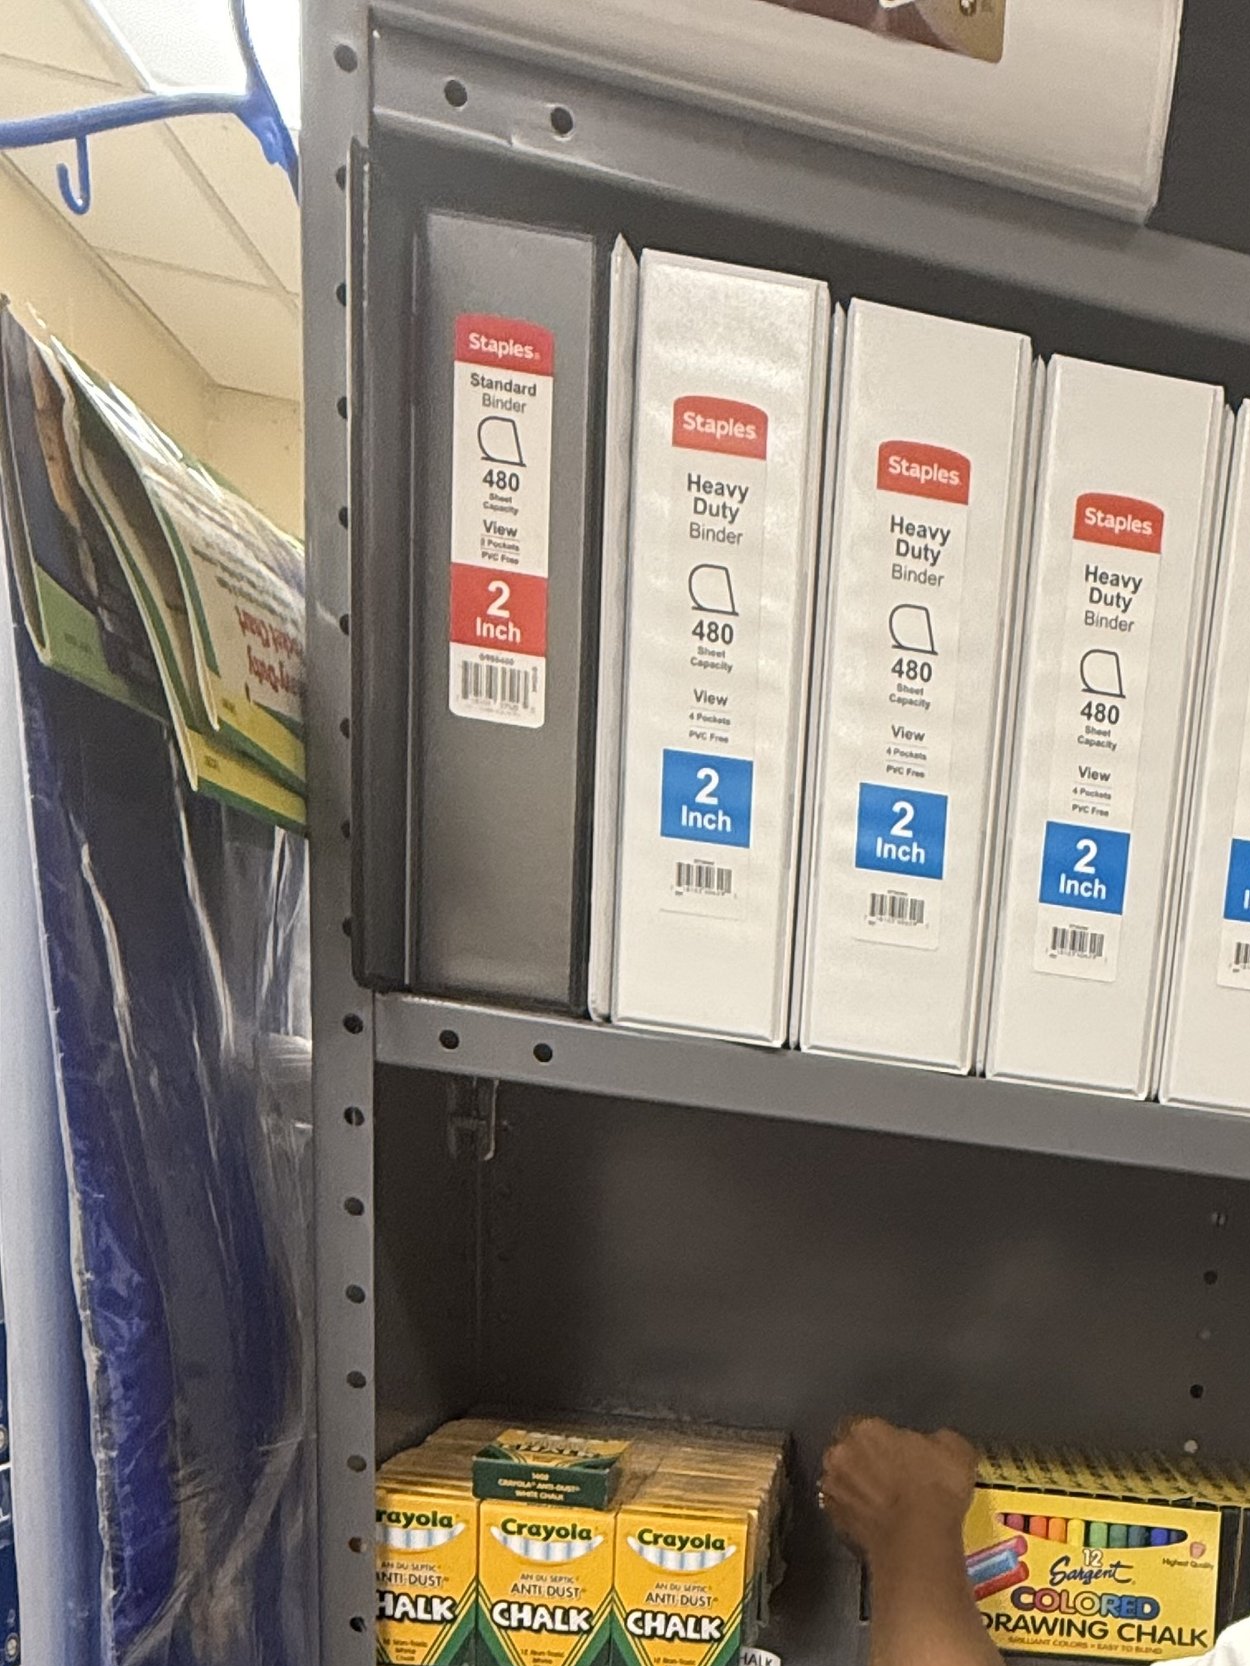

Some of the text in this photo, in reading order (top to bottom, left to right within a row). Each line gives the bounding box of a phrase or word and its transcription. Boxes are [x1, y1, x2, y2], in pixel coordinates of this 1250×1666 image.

[468, 332, 534, 359] Staples
[470, 372, 536, 396] Standard
[482, 394, 526, 413] Binder
[683, 411, 757, 440] Staples
[482, 469, 520, 492] 480
[888, 455, 961, 485] Staples
[687, 472, 749, 504] Heavy
[693, 497, 740, 524] Duty
[1084, 507, 1153, 535] Staples
[483, 519, 518, 538] View
[689, 522, 743, 546] Binder
[891, 515, 951, 547] Heavy
[896, 538, 941, 566] Duty
[892, 563, 944, 587] Binder
[1085, 564, 1143, 594] Heavy
[486, 581, 510, 618] 2
[1089, 587, 1132, 613] Duty
[476, 617, 521, 643] Inch
[692, 620, 734, 645] 480
[1084, 610, 1134, 632] Binder
[891, 658, 932, 683] 480
[693, 689, 728, 707] View
[1080, 701, 1120, 725] 480
[891, 725, 925, 742] View
[695, 767, 720, 805] 2
[1078, 765, 1111, 782] View
[681, 805, 732, 832] Inch
[890, 800, 915, 838] 2
[876, 837, 925, 864] Inch
[1073, 838, 1098, 875] 2
[1059, 873, 1106, 900] Inch
[501, 1518, 592, 1541] Crayola
[637, 1528, 726, 1551] Crayola
[1049, 1555, 1134, 1586] Sargent
[1083, 1549, 1103, 1567] 12
[1162, 1557, 1214, 1570] Highest Quality
[409, 1573, 442, 1587] DUST
[511, 1583, 579, 1598] ANTI DUST
[646, 1592, 712, 1606] ANTI DUST
[1011, 1586, 1160, 1621] COLORED
[492, 1602, 591, 1632] CHALK
[626, 1611, 721, 1640] CHALK
[982, 1612, 1208, 1648] DRAWING CHALK
